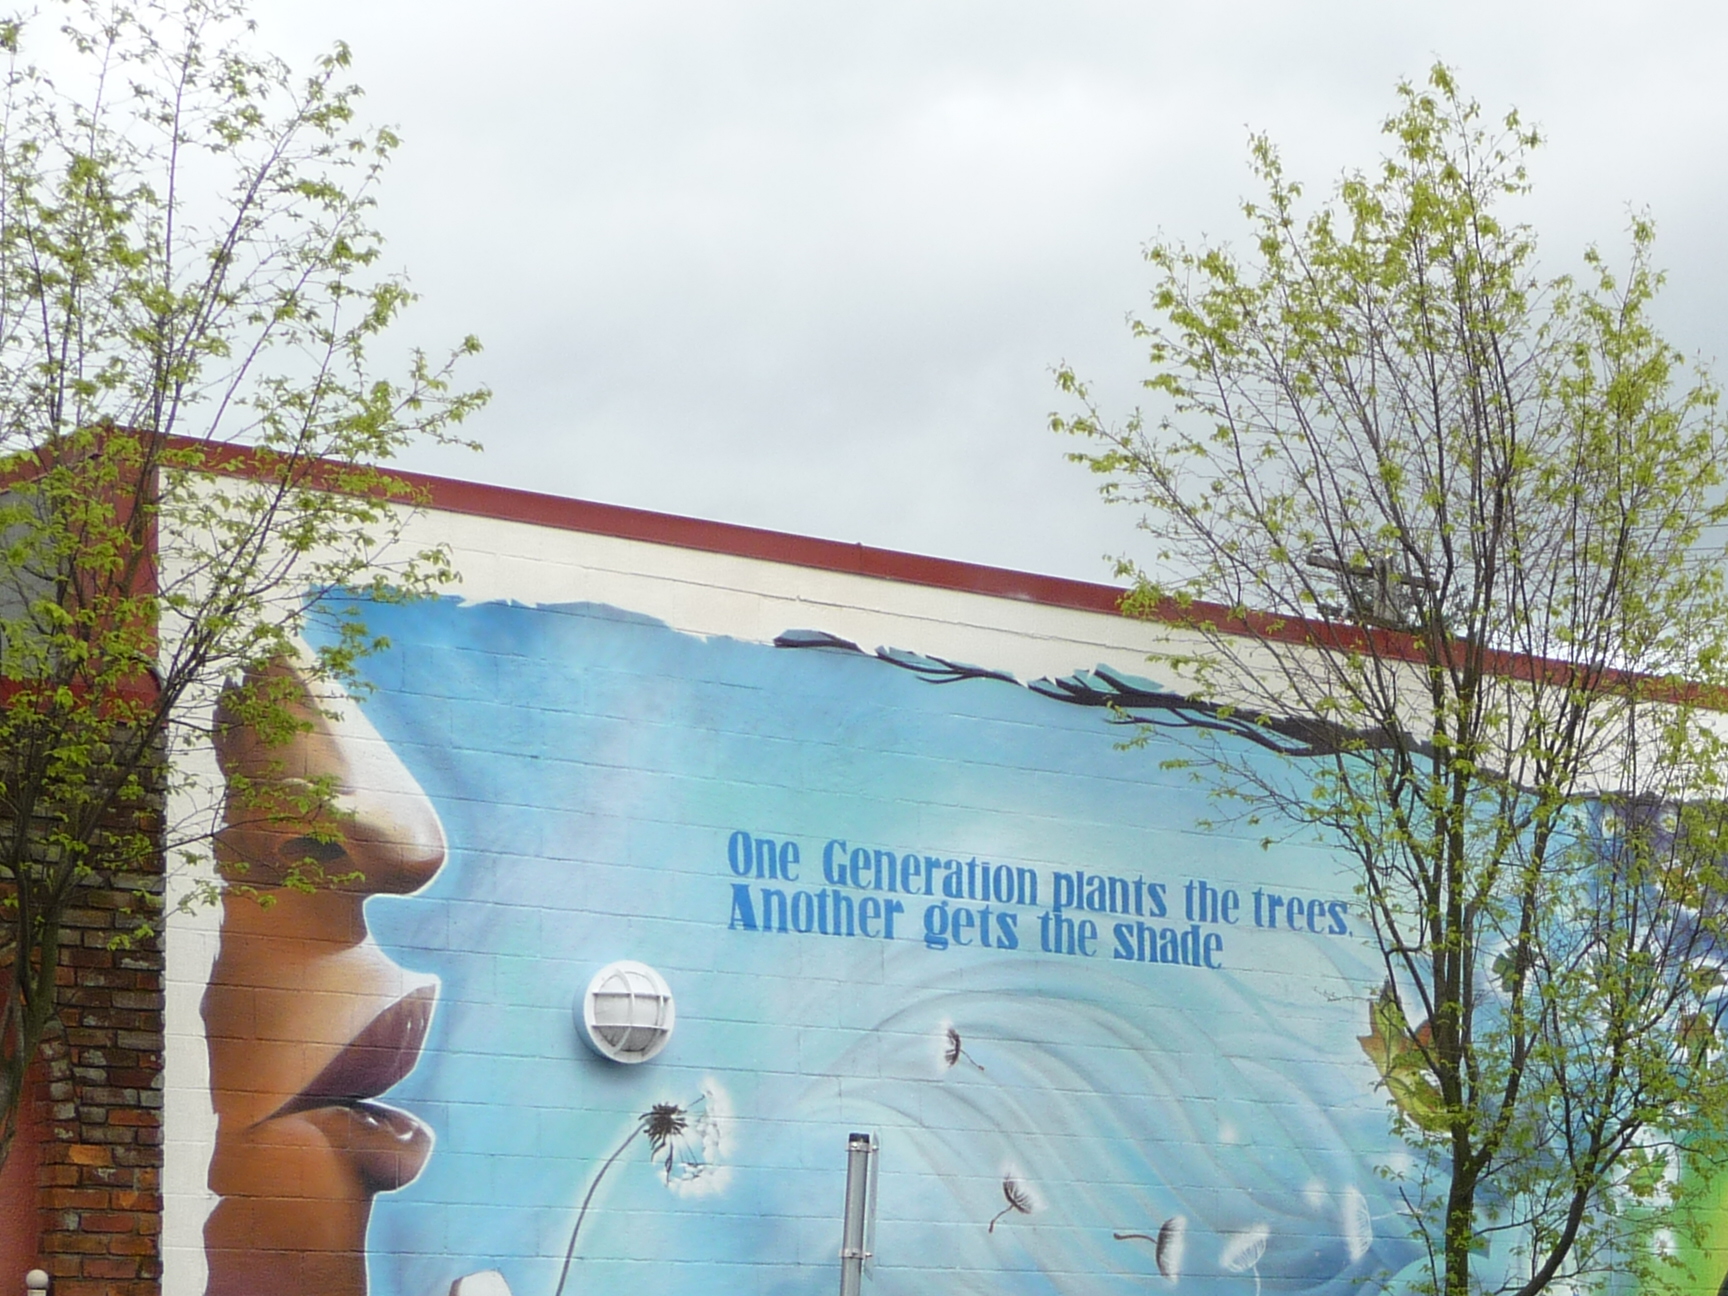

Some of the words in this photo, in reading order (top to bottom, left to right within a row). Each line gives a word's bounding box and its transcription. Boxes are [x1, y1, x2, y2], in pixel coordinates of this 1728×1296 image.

[728, 830, 800, 882] One
[822, 839, 1038, 906] Generation
[1052, 870, 1167, 918] plants
[1184, 879, 1240, 925] the
[727, 883, 905, 940] Another
[923, 900, 1019, 951] gets
[1036, 910, 1098, 957] the
[1112, 921, 1224, 969] shade
